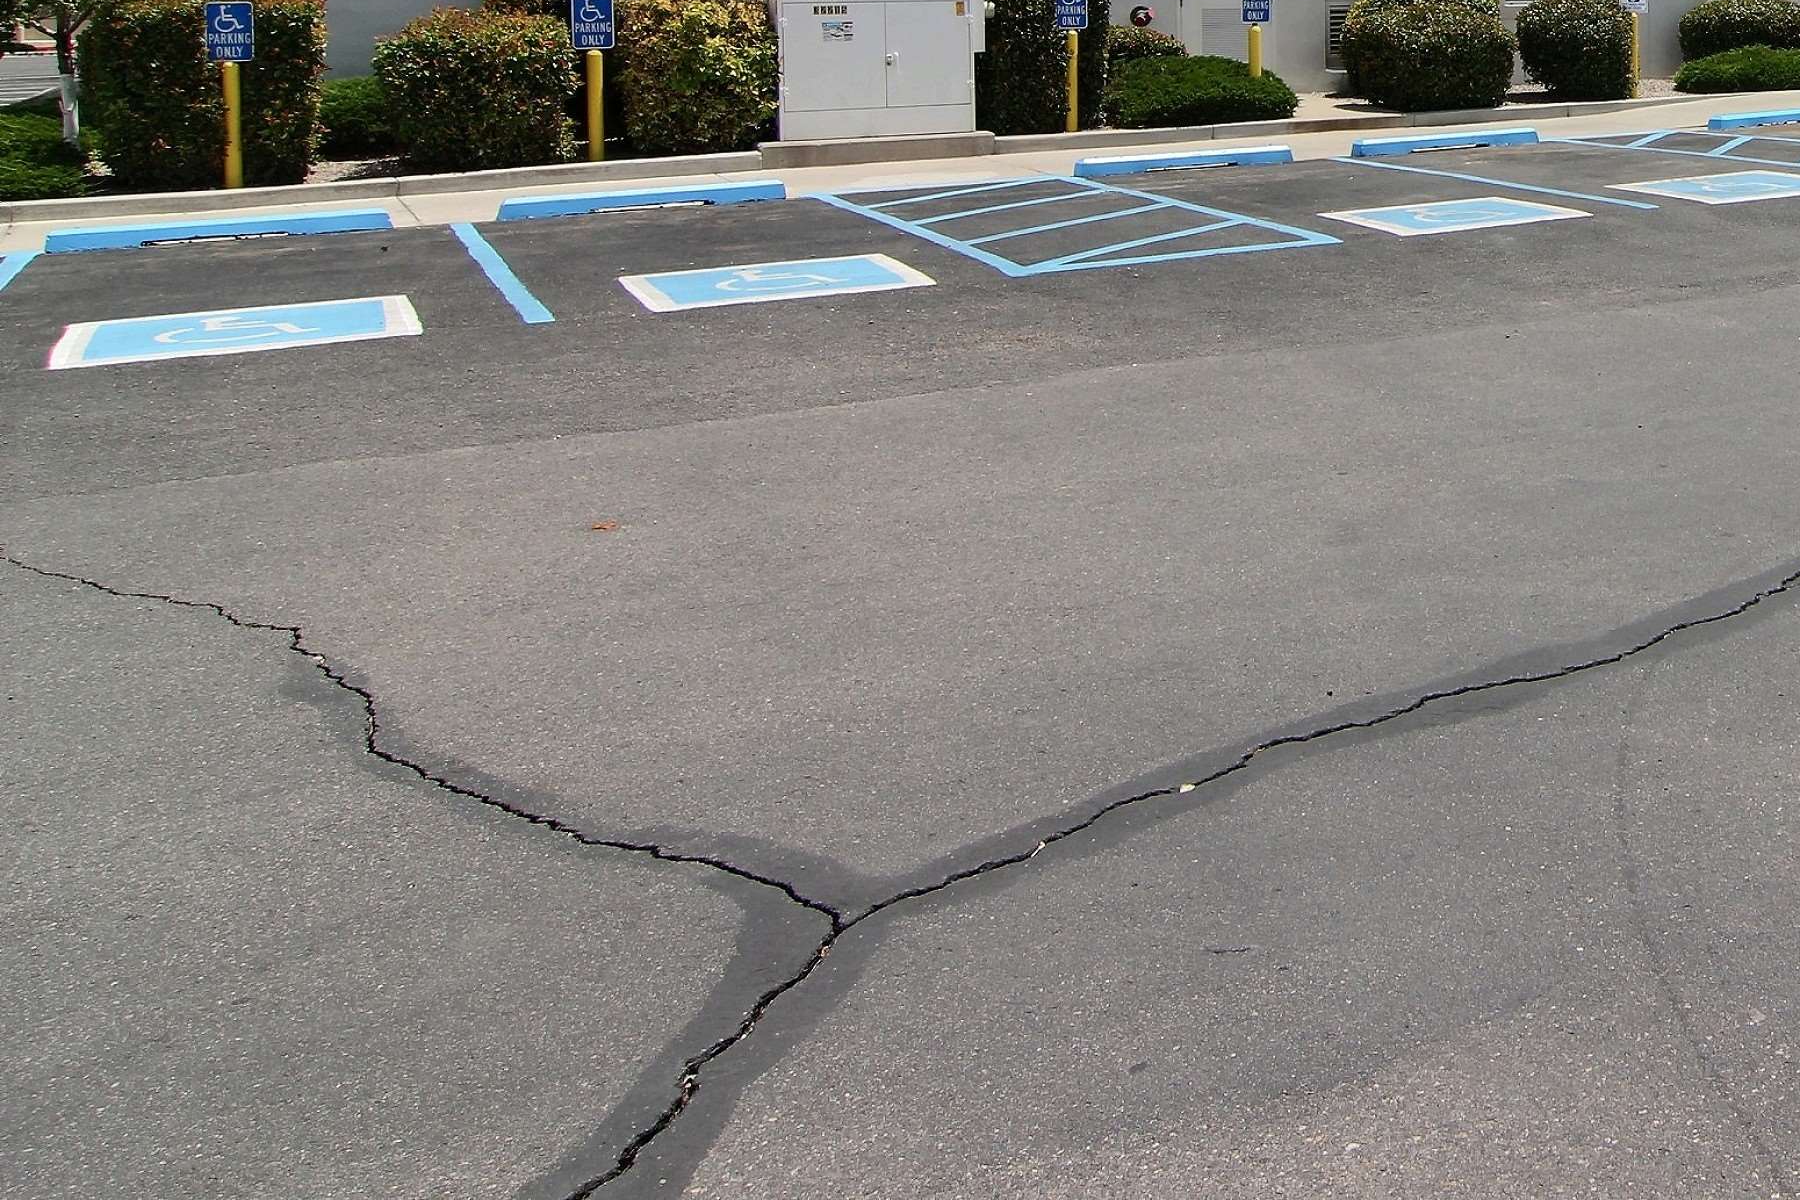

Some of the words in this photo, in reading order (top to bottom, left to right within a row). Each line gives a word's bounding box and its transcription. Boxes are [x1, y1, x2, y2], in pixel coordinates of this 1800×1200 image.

[1062, 16, 1080, 26] ONLY
[1247, 11, 1264, 20] ONLY
[575, 22, 612, 33] PARKING
[208, 32, 251, 44] PARKING
[581, 34, 605, 46] ONLY
[216, 46, 243, 58] ONLY
